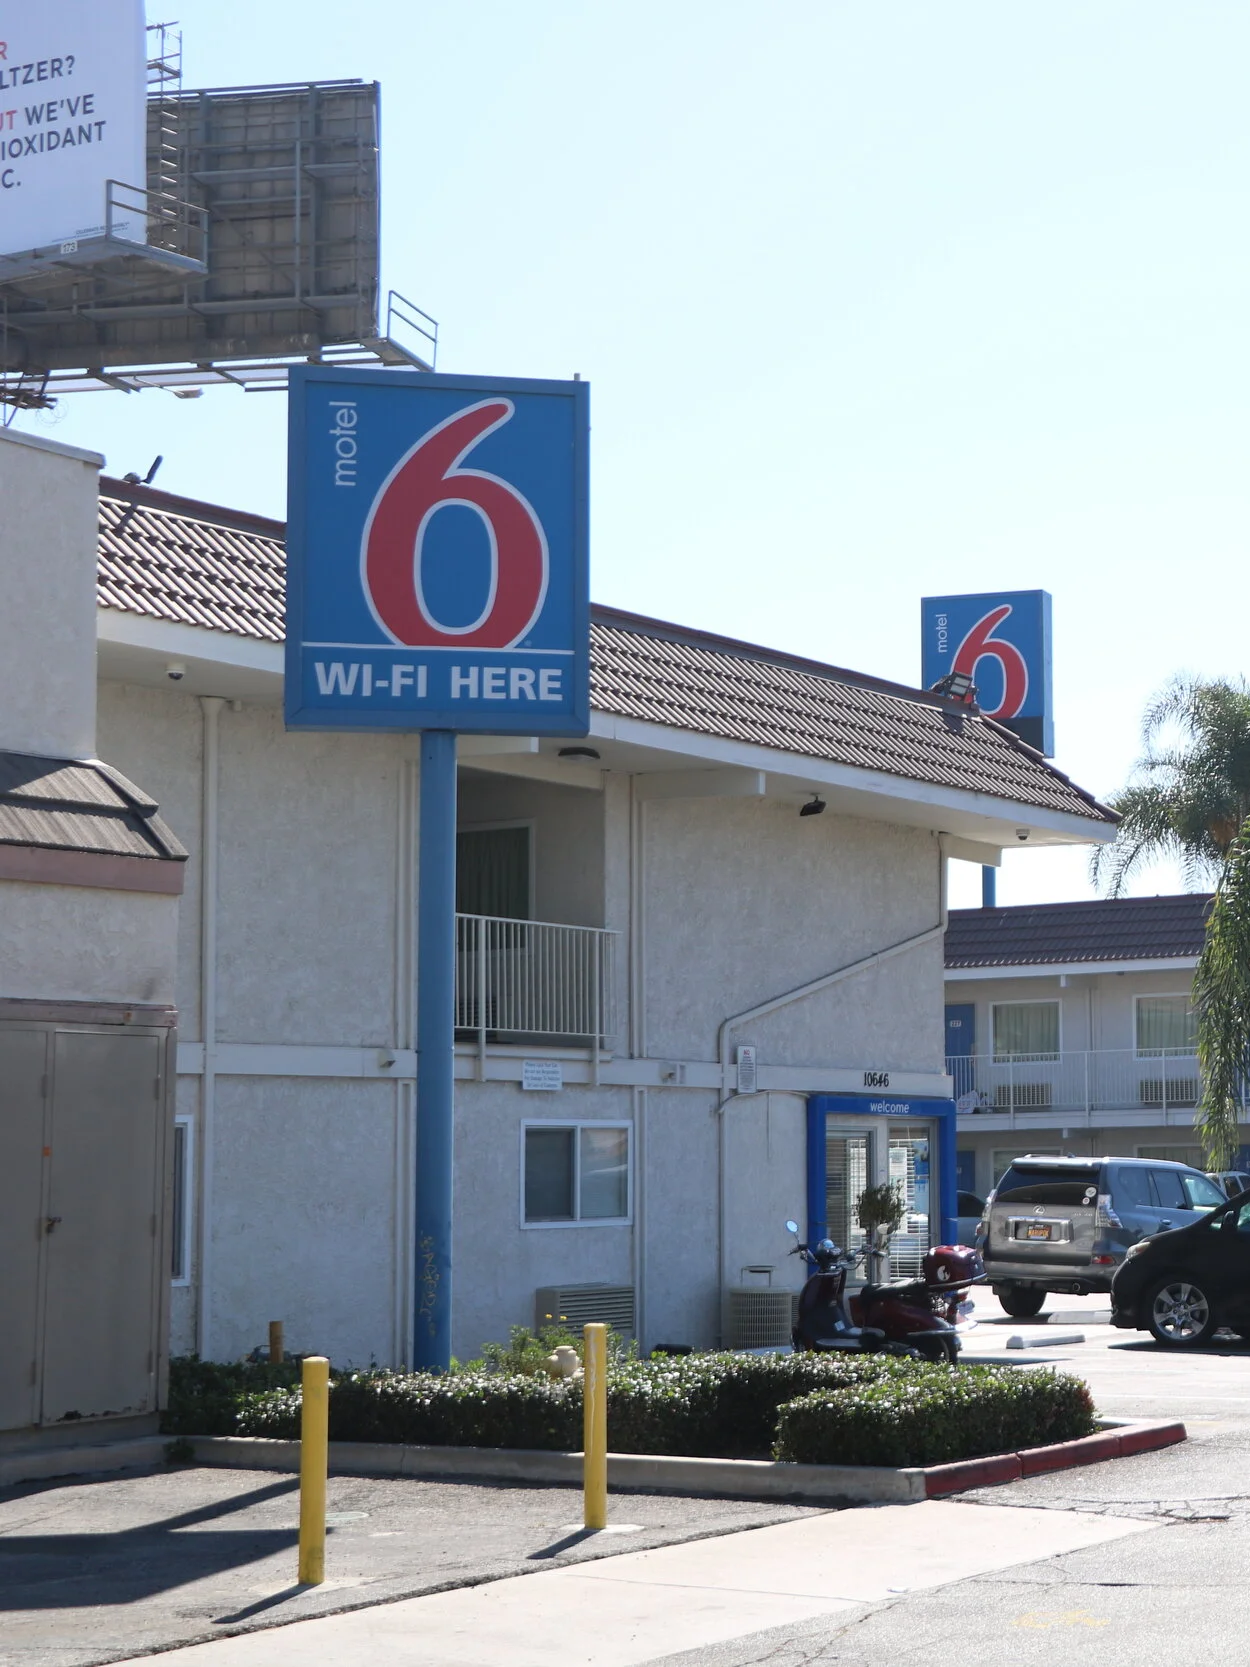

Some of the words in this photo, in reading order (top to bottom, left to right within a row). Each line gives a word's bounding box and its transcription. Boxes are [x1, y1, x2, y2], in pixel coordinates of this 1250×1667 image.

[0, 55, 75, 90] LTZER?
[25, 93, 94, 126] WE'VE
[1, 120, 107, 161] IOXIDANT
[1, 168, 21, 189] C.
[329, 401, 357, 487] motel
[359, 397, 549, 649] 6
[936, 613, 948, 653] motel
[950, 604, 1029, 719] 6
[314, 662, 427, 698] WI-FI
[451, 665, 563, 701] HERE
[863, 1071, 890, 1088] 10646
[870, 1100, 910, 1114] welcome
